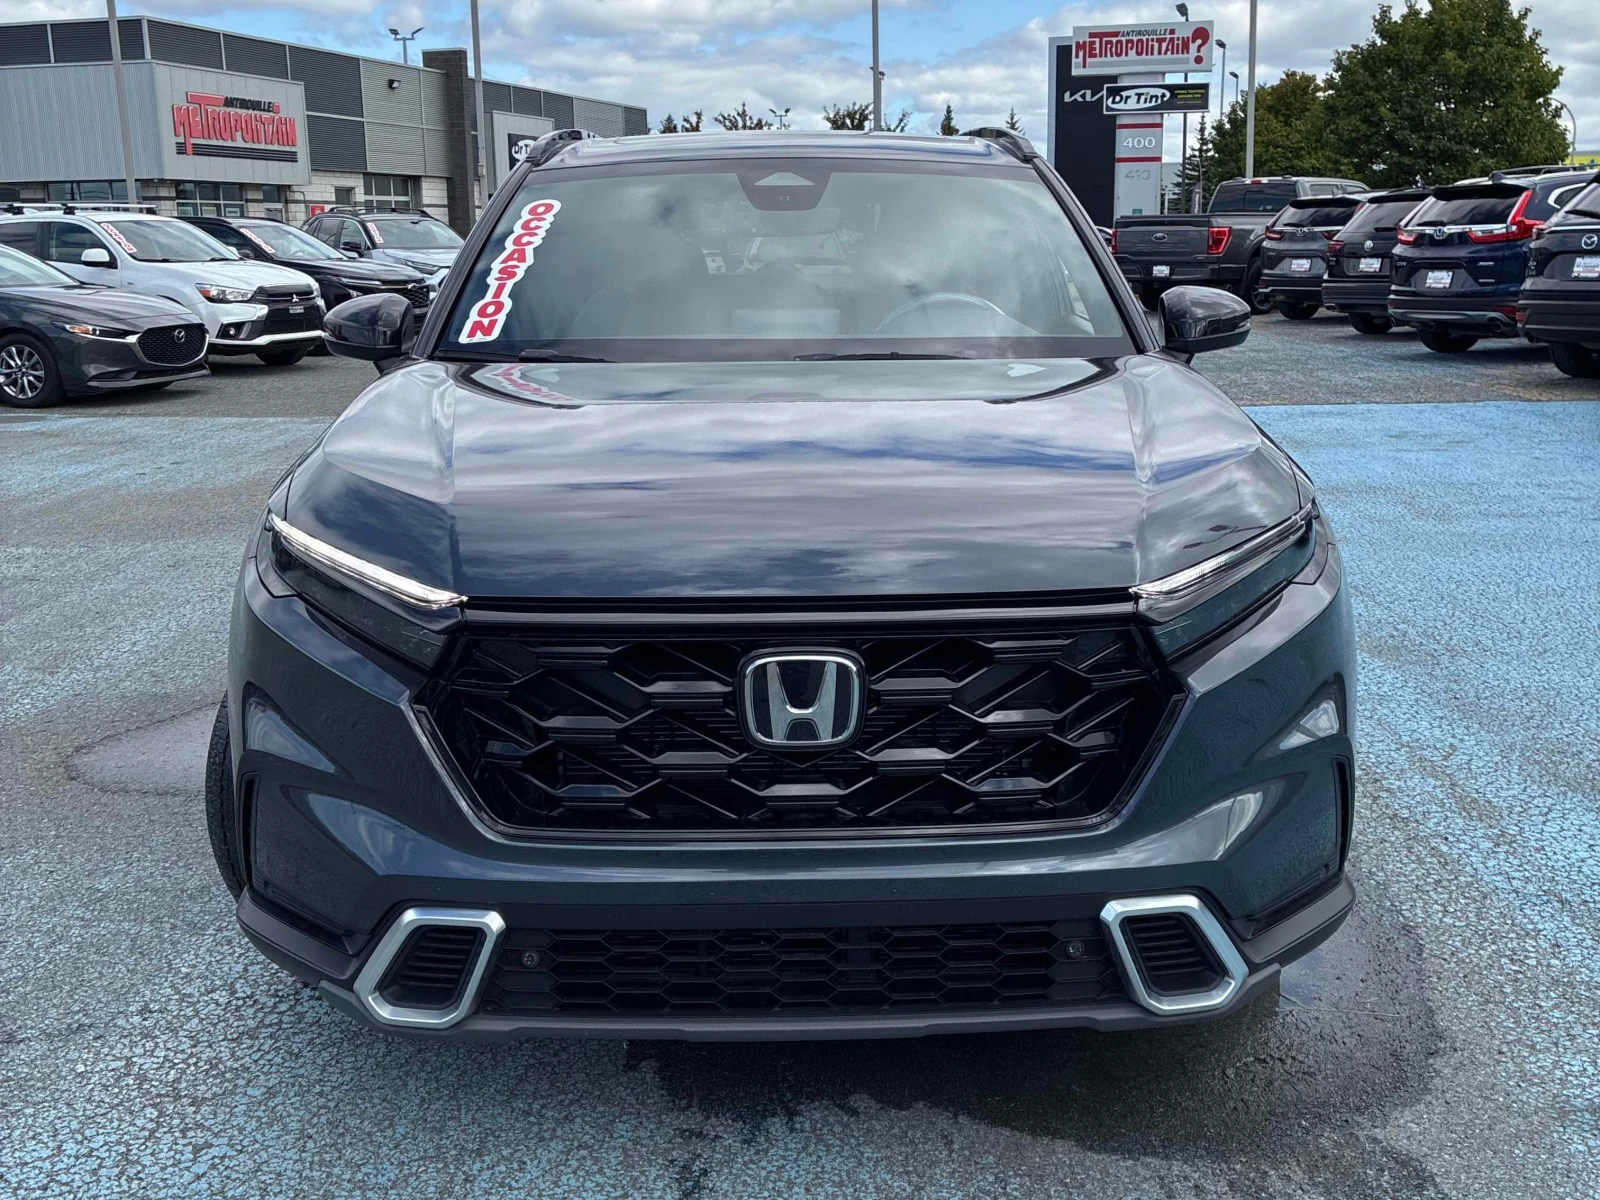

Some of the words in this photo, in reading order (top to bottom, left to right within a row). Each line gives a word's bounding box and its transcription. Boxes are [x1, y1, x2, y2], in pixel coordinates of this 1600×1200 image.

[1120, 28, 1168, 38] ANTIROUILLE
[1110, 93, 1131, 105] Dr
[1134, 91, 1167, 105] Tint
[1122, 136, 1156, 149] 400
[465, 202, 555, 338] OCCASION
